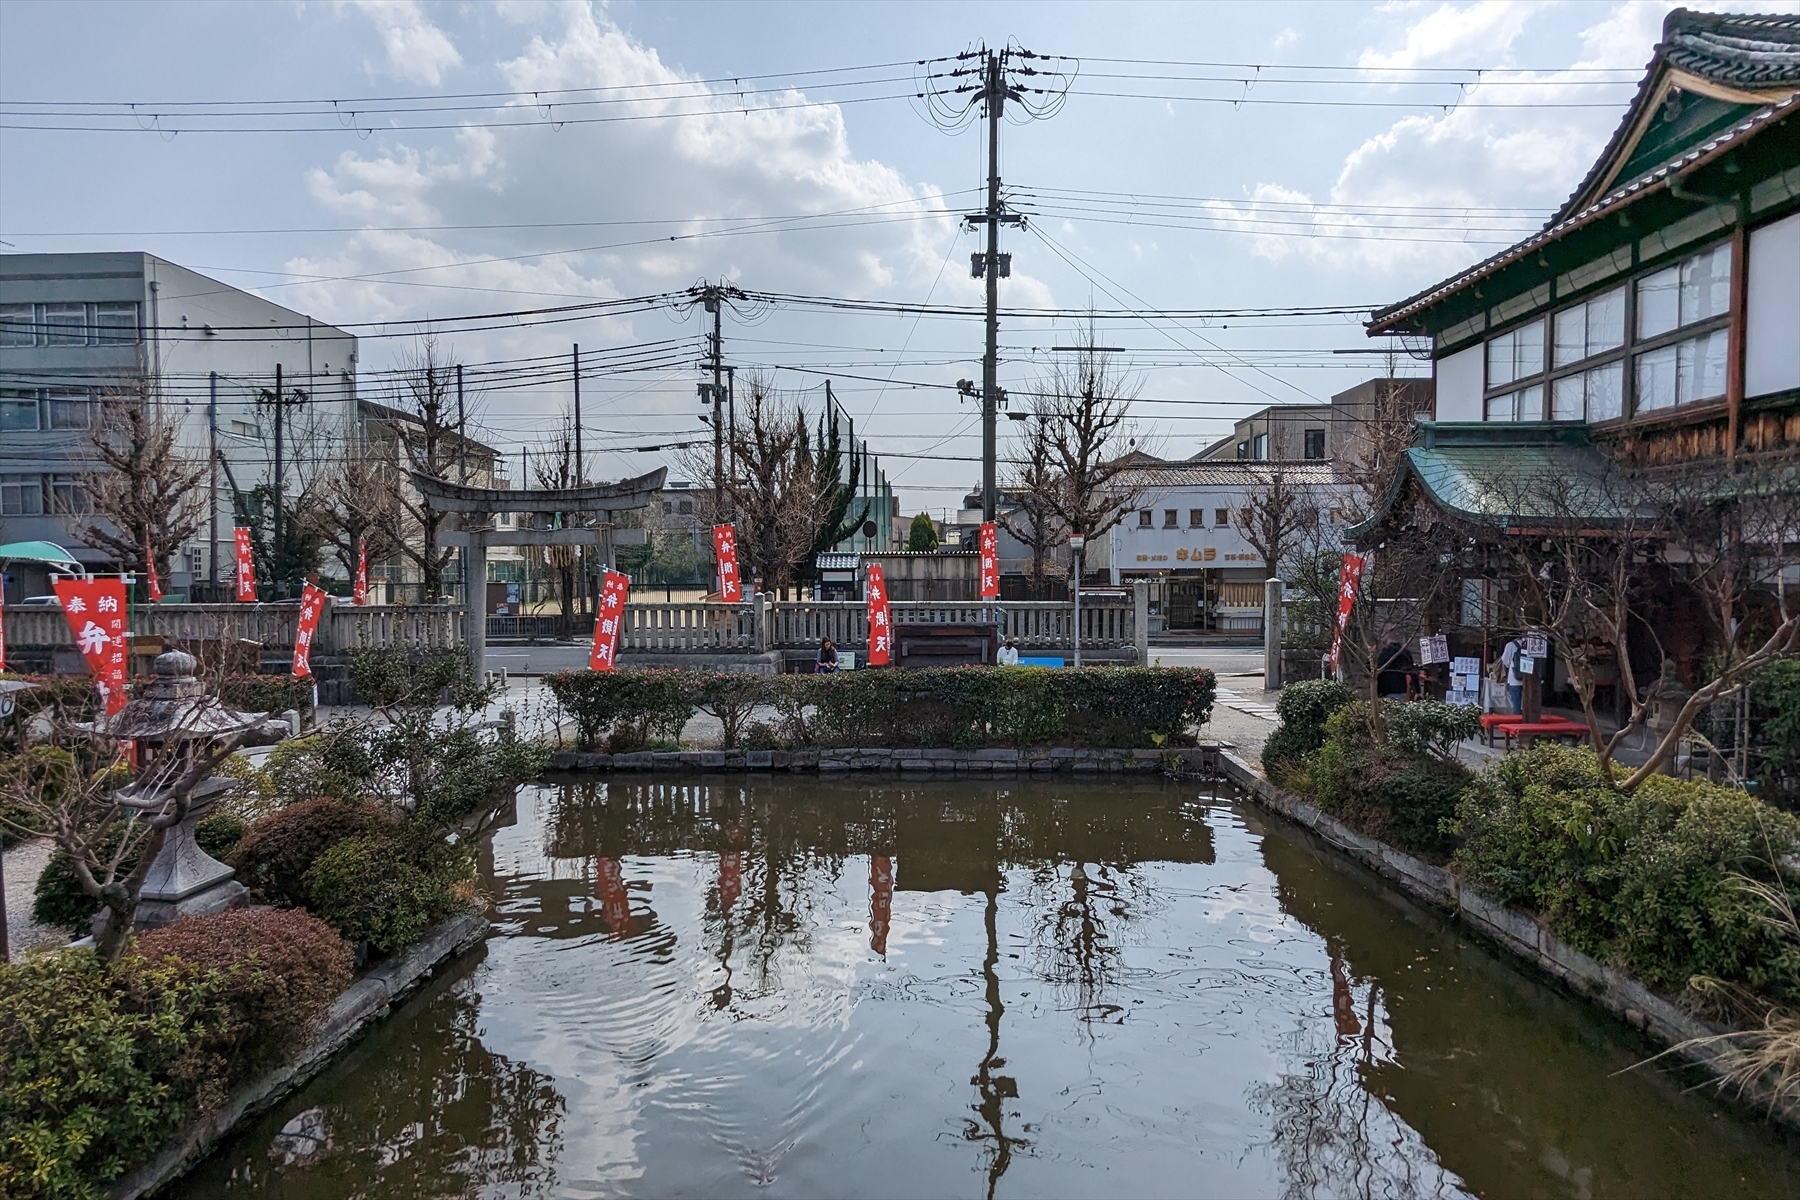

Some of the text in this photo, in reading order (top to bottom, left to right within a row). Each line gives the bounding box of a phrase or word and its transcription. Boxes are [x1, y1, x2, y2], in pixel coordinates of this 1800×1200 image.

[721, 541, 736, 594] 弁財天
[1176, 548, 1216, 561] キムラ
[67, 596, 118, 613] 奉納
[111, 619, 123, 680] 開運招福
